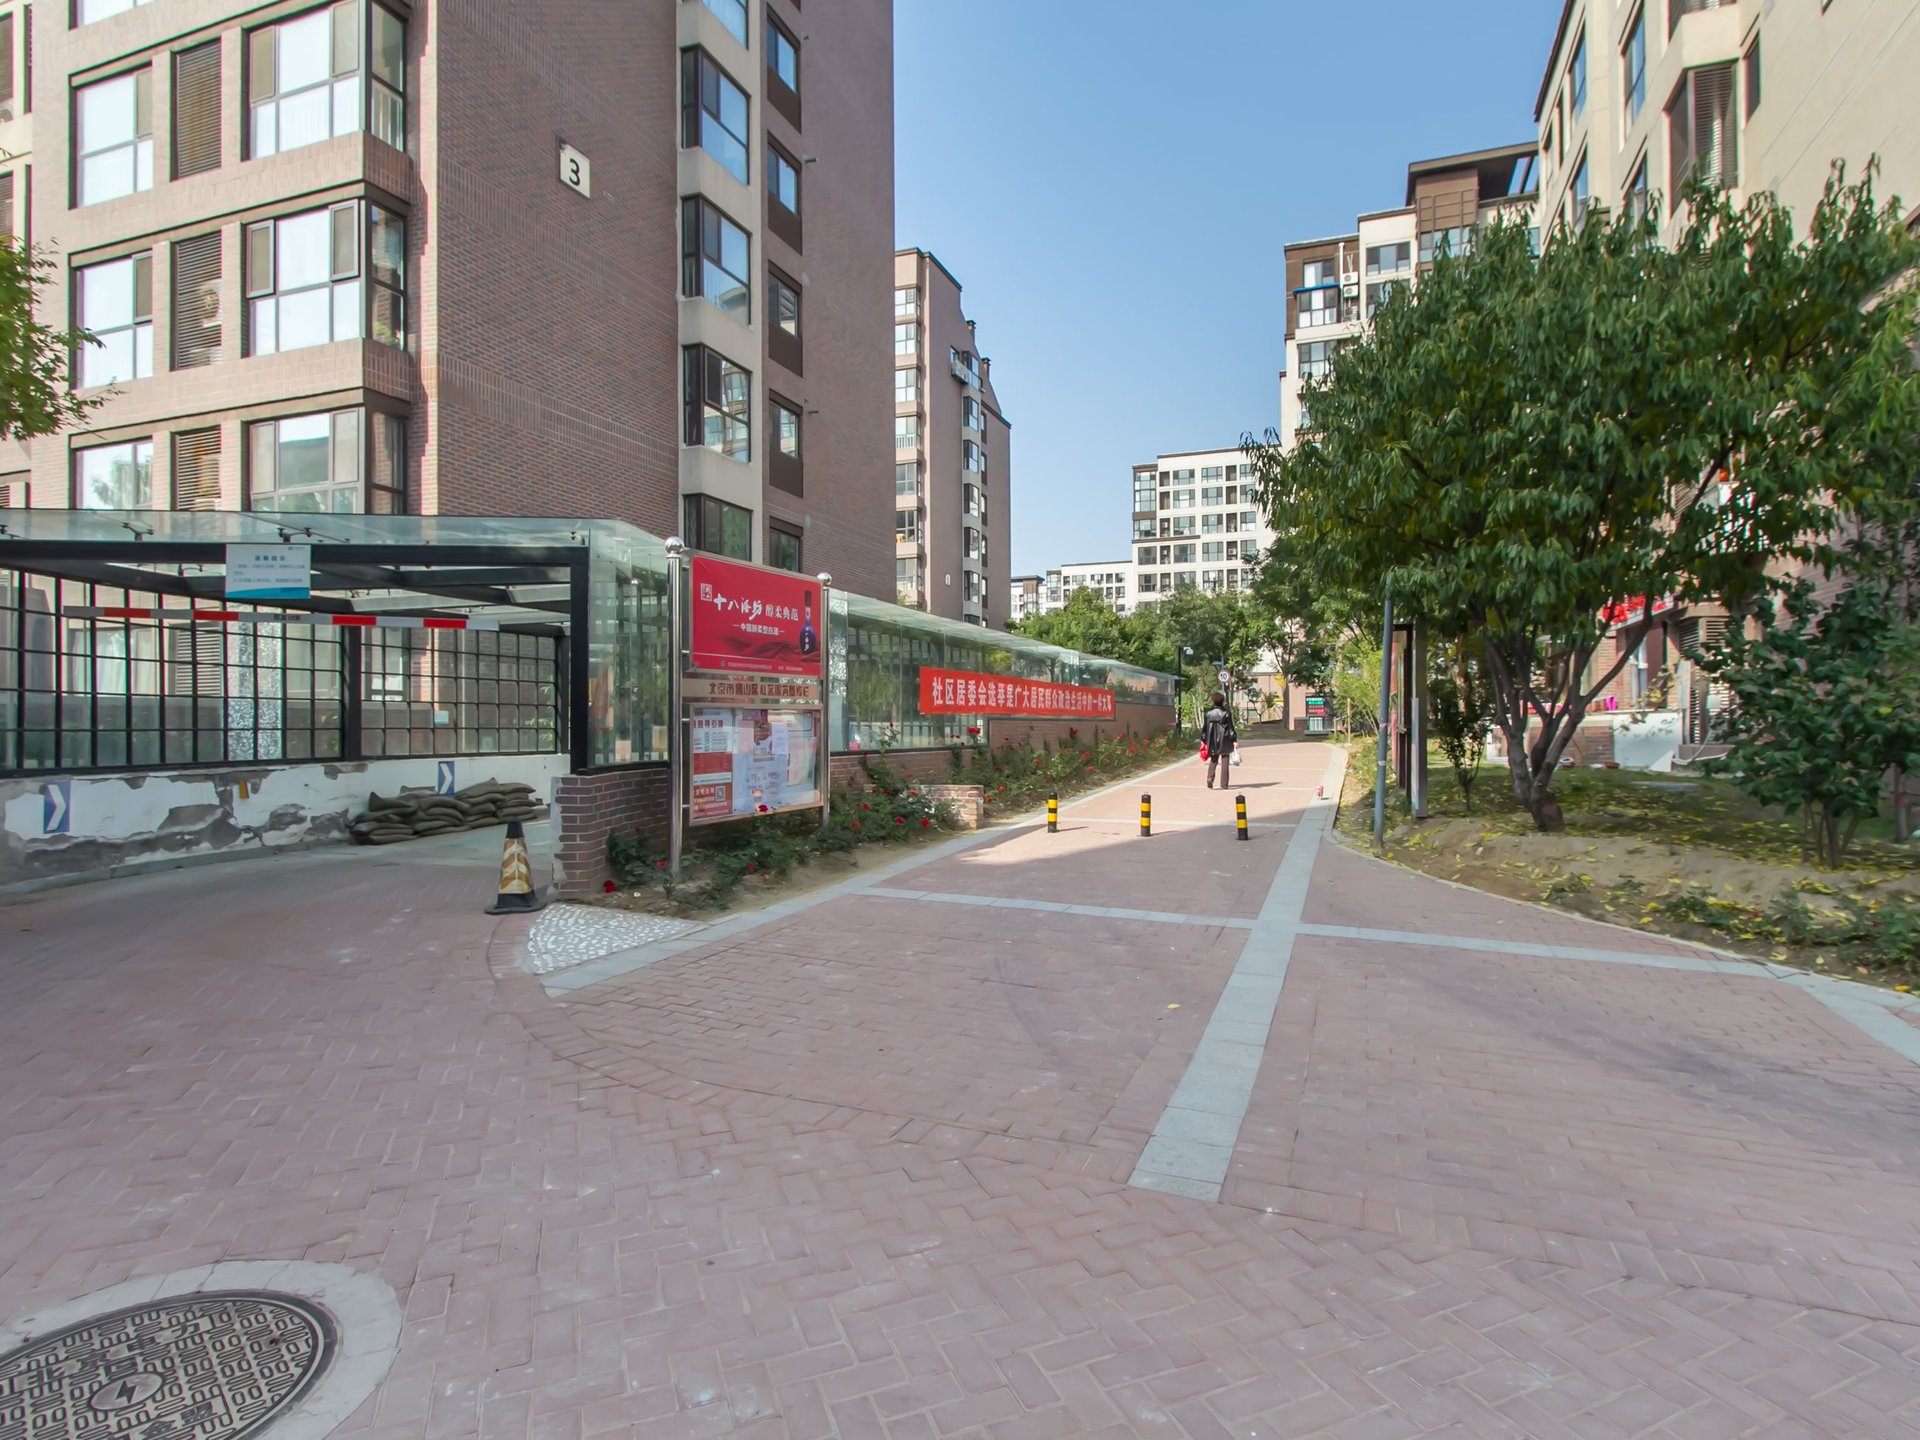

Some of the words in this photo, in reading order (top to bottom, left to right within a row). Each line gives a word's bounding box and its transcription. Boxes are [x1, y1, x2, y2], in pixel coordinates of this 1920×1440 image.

[569, 158, 580, 186] 3
[713, 592, 763, 621] 十八酒坊
[932, 676, 1112, 712] 社区居委会选举是广大居民群众政治生活中的一件大事
[27, 1323, 200, 1385] 北京电力
